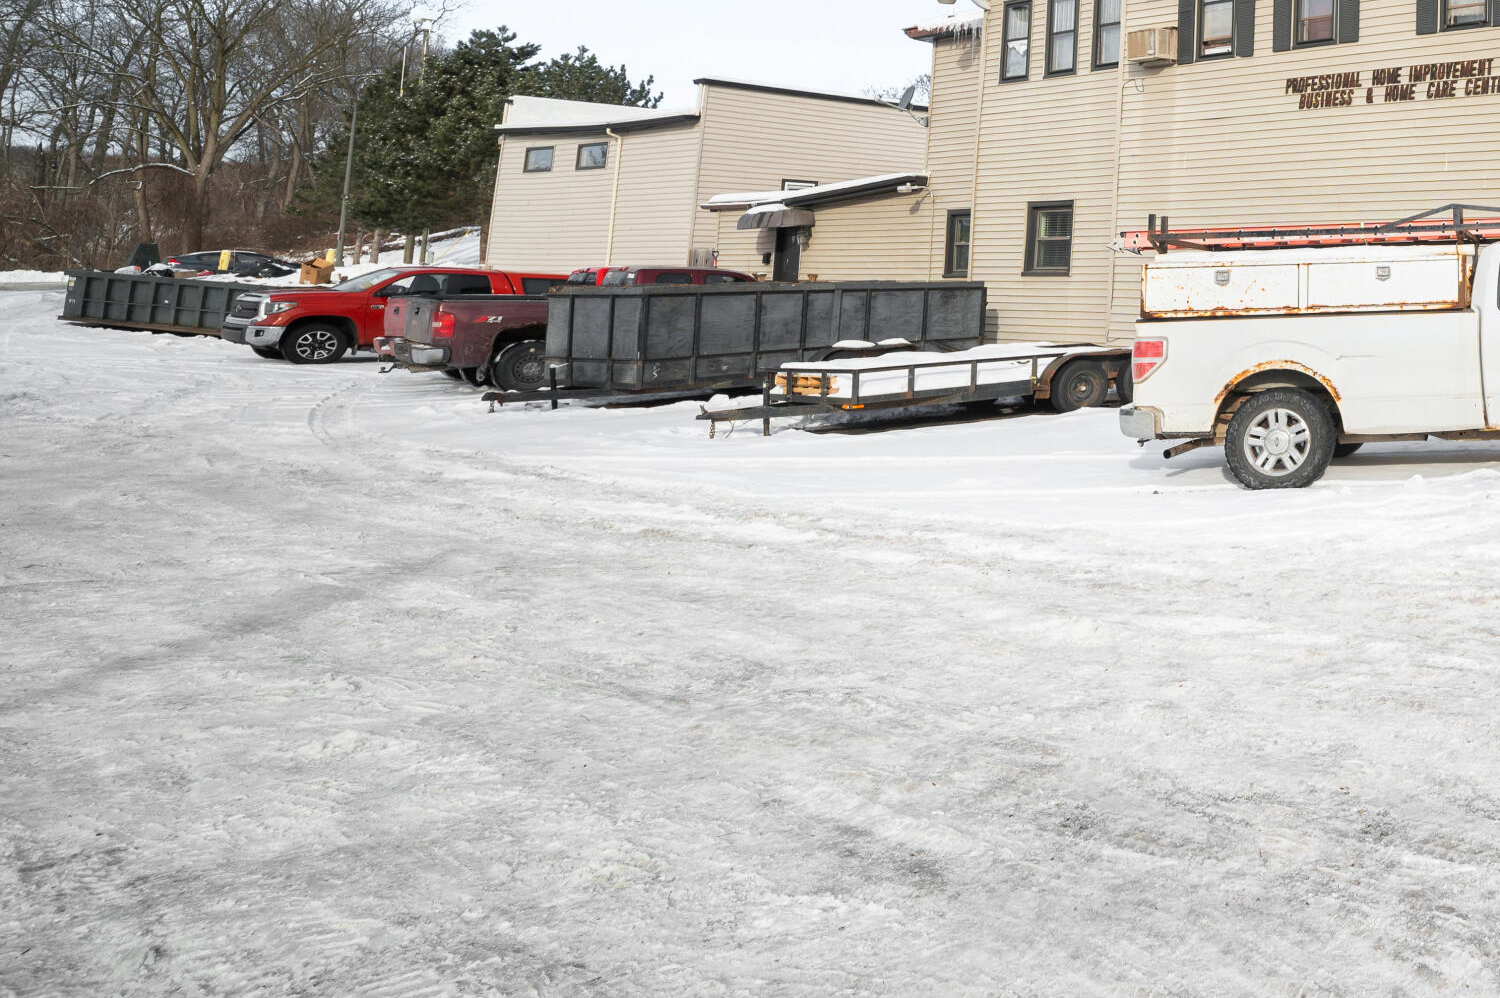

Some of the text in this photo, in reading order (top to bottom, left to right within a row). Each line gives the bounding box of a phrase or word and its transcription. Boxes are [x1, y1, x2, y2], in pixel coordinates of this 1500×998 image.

[1285, 71, 1362, 95] PROFESSIONAL
[1372, 66, 1403, 86] HOME
[1408, 57, 1495, 83] IMPROVEMENT
[1298, 89, 1355, 110] BUSINESS
[1365, 87, 1374, 104] &
[1384, 83, 1417, 103] HOME
[1426, 79, 1459, 99] CARE
